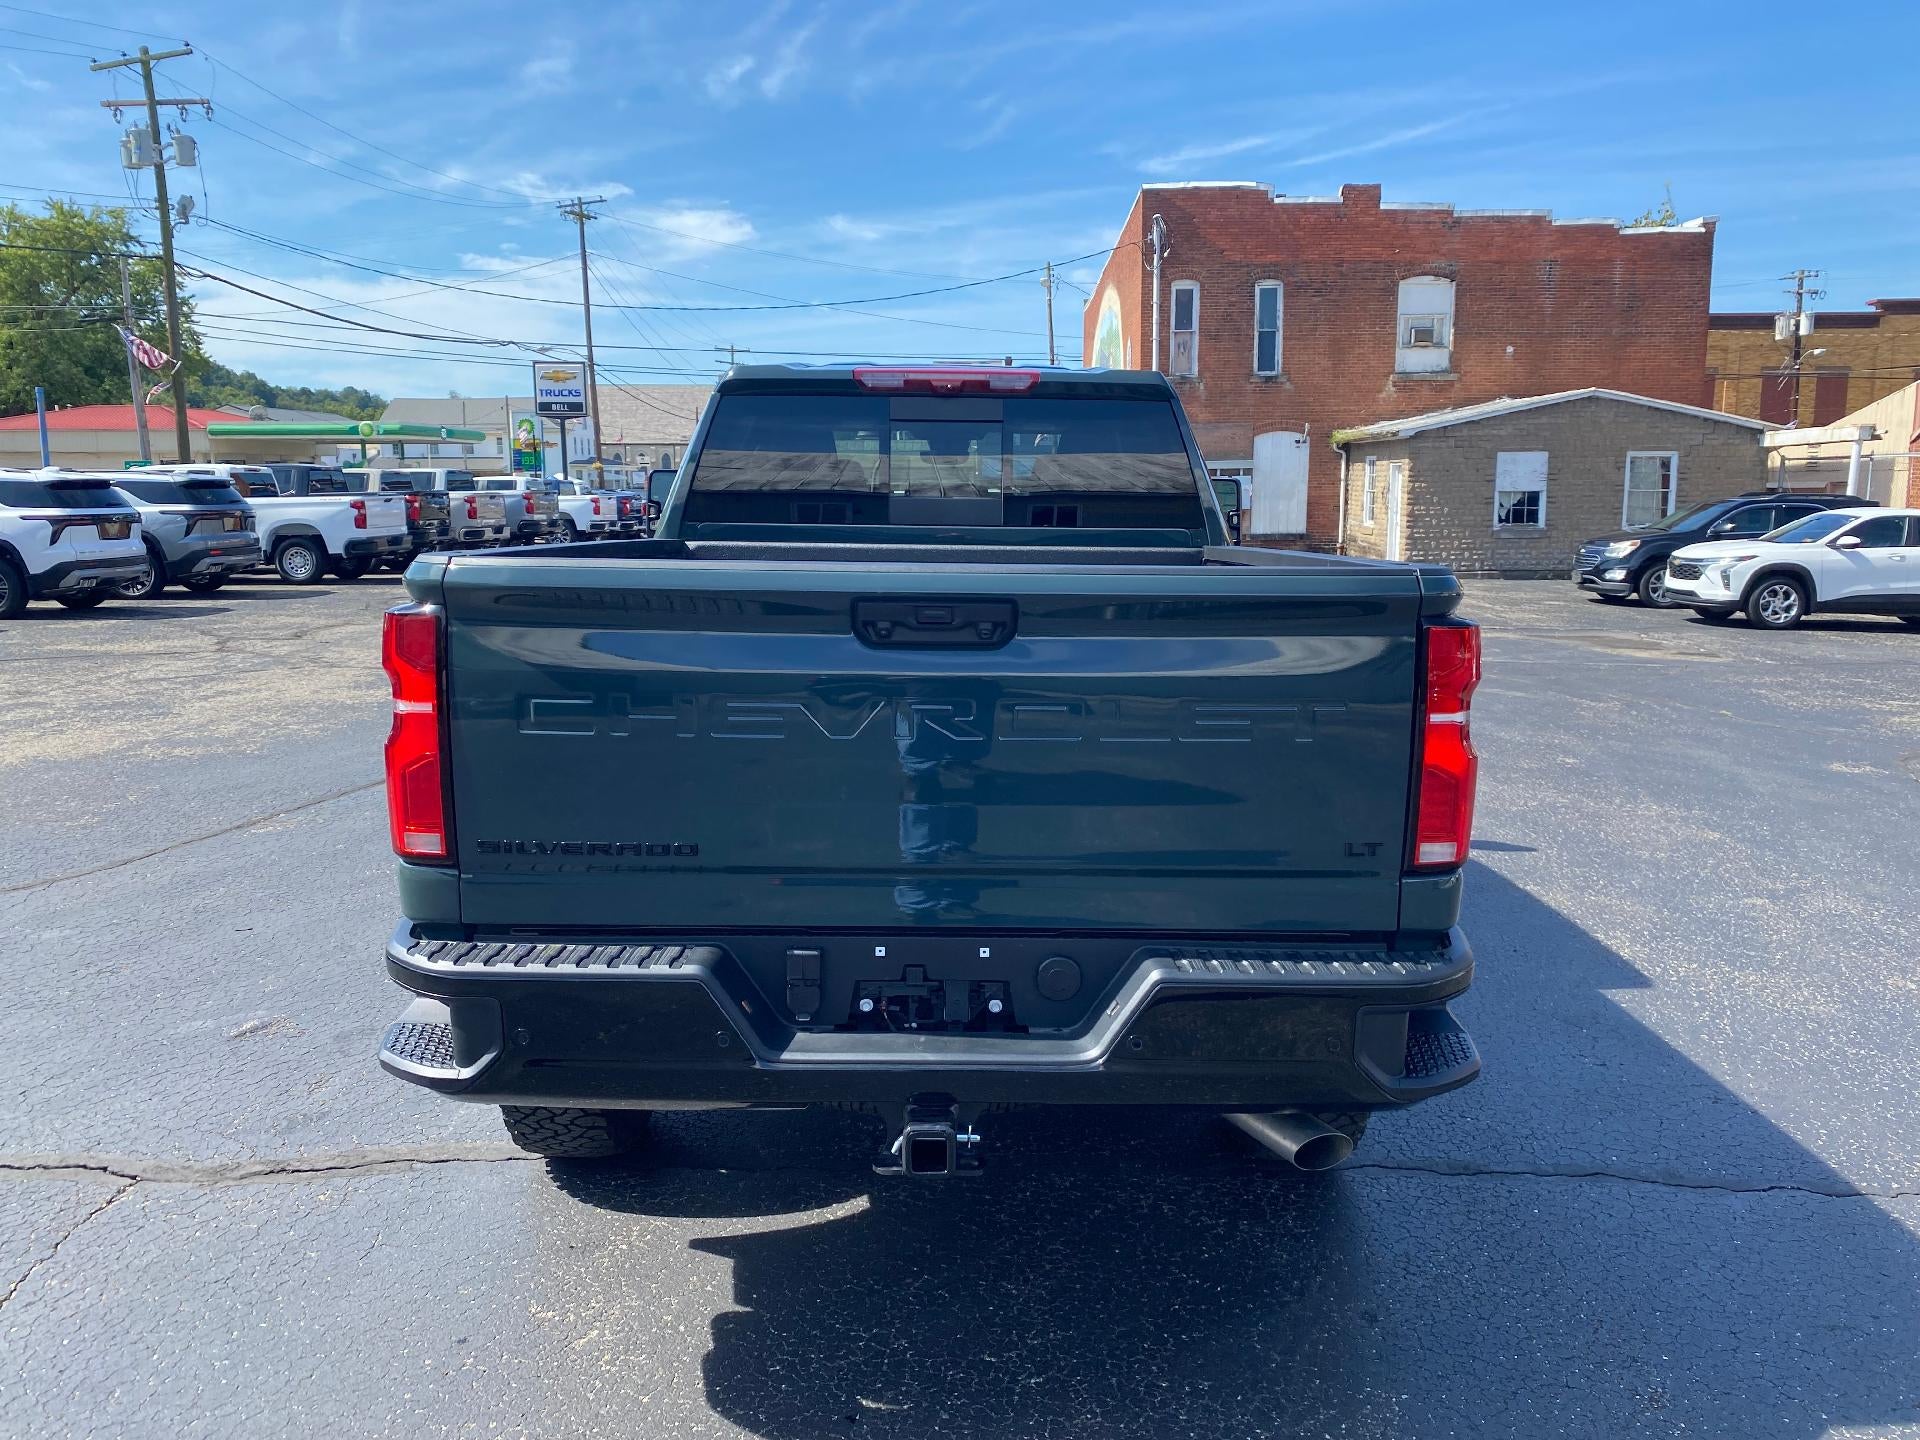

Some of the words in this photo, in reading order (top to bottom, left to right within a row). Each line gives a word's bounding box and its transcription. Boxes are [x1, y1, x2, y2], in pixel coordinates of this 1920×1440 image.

[539, 388, 582, 397] TRUCKS
[551, 403, 569, 411] BELL
[516, 693, 1347, 742] CHEVROLET
[476, 839, 699, 857] SILVERADO
[1344, 841, 1385, 857] LT
